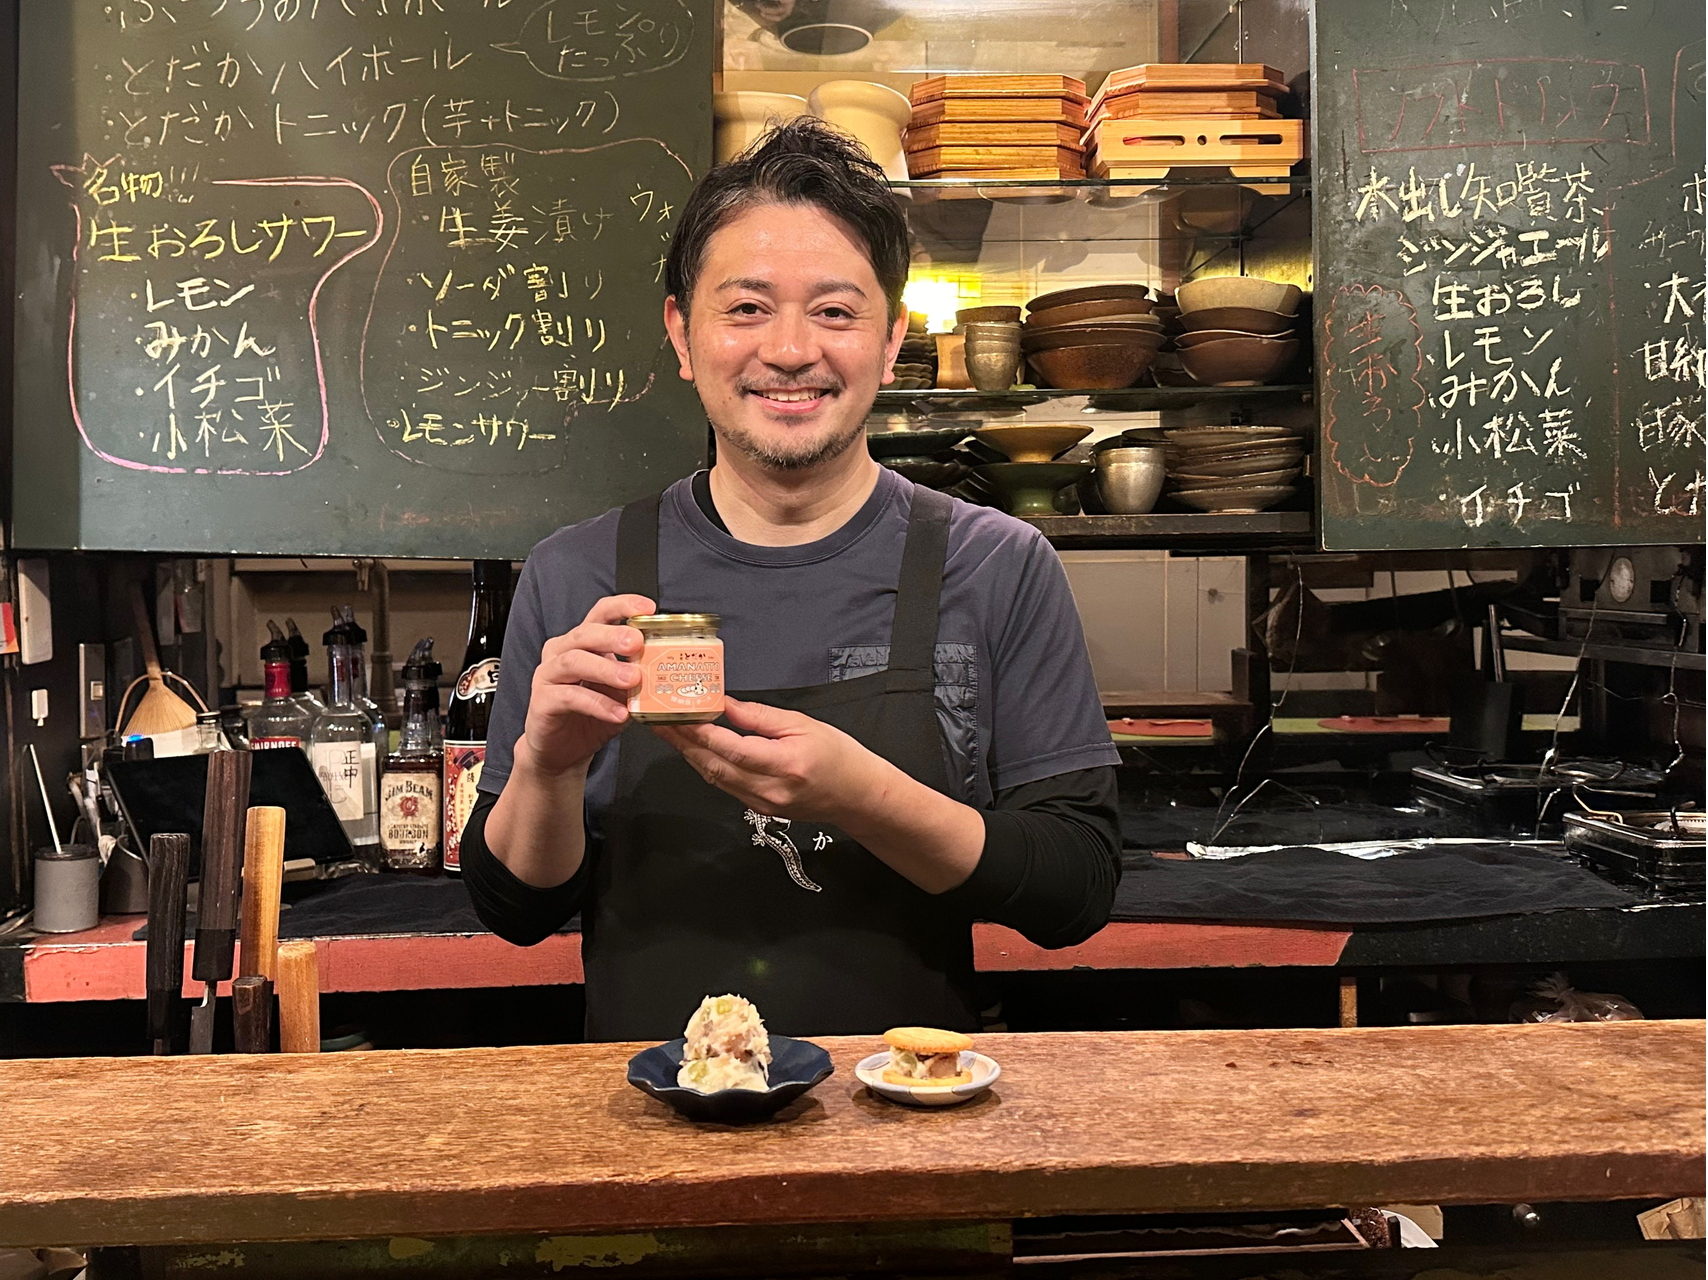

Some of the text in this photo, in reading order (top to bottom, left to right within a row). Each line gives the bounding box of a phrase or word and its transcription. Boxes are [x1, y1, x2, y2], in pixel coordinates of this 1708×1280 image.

[547, 4, 642, 43] レモン
[411, 153, 520, 197] 自家製
[439, 199, 614, 252] 生姜漬け
[146, 278, 254, 312] レモン
[419, 263, 603, 303] ソーダ割り
[1431, 274, 1582, 321] 生おろし
[144, 321, 276, 363] みかん
[427, 308, 606, 352] トニック割り
[1444, 326, 1553, 369] レモン
[153, 364, 281, 409] イチゴ
[1439, 357, 1571, 408] みかん
[152, 400, 312, 462] 小松菜
[401, 408, 556, 450] レモンサワー
[1443, 408, 1588, 459] 小松菜
[1461, 482, 1581, 527] イチゴ
[657, 662, 720, 671] AMANATTO
[670, 673, 712, 682] CHEESE
[385, 780, 433, 801] JIM BEAM
[813, 831, 834, 851] か
